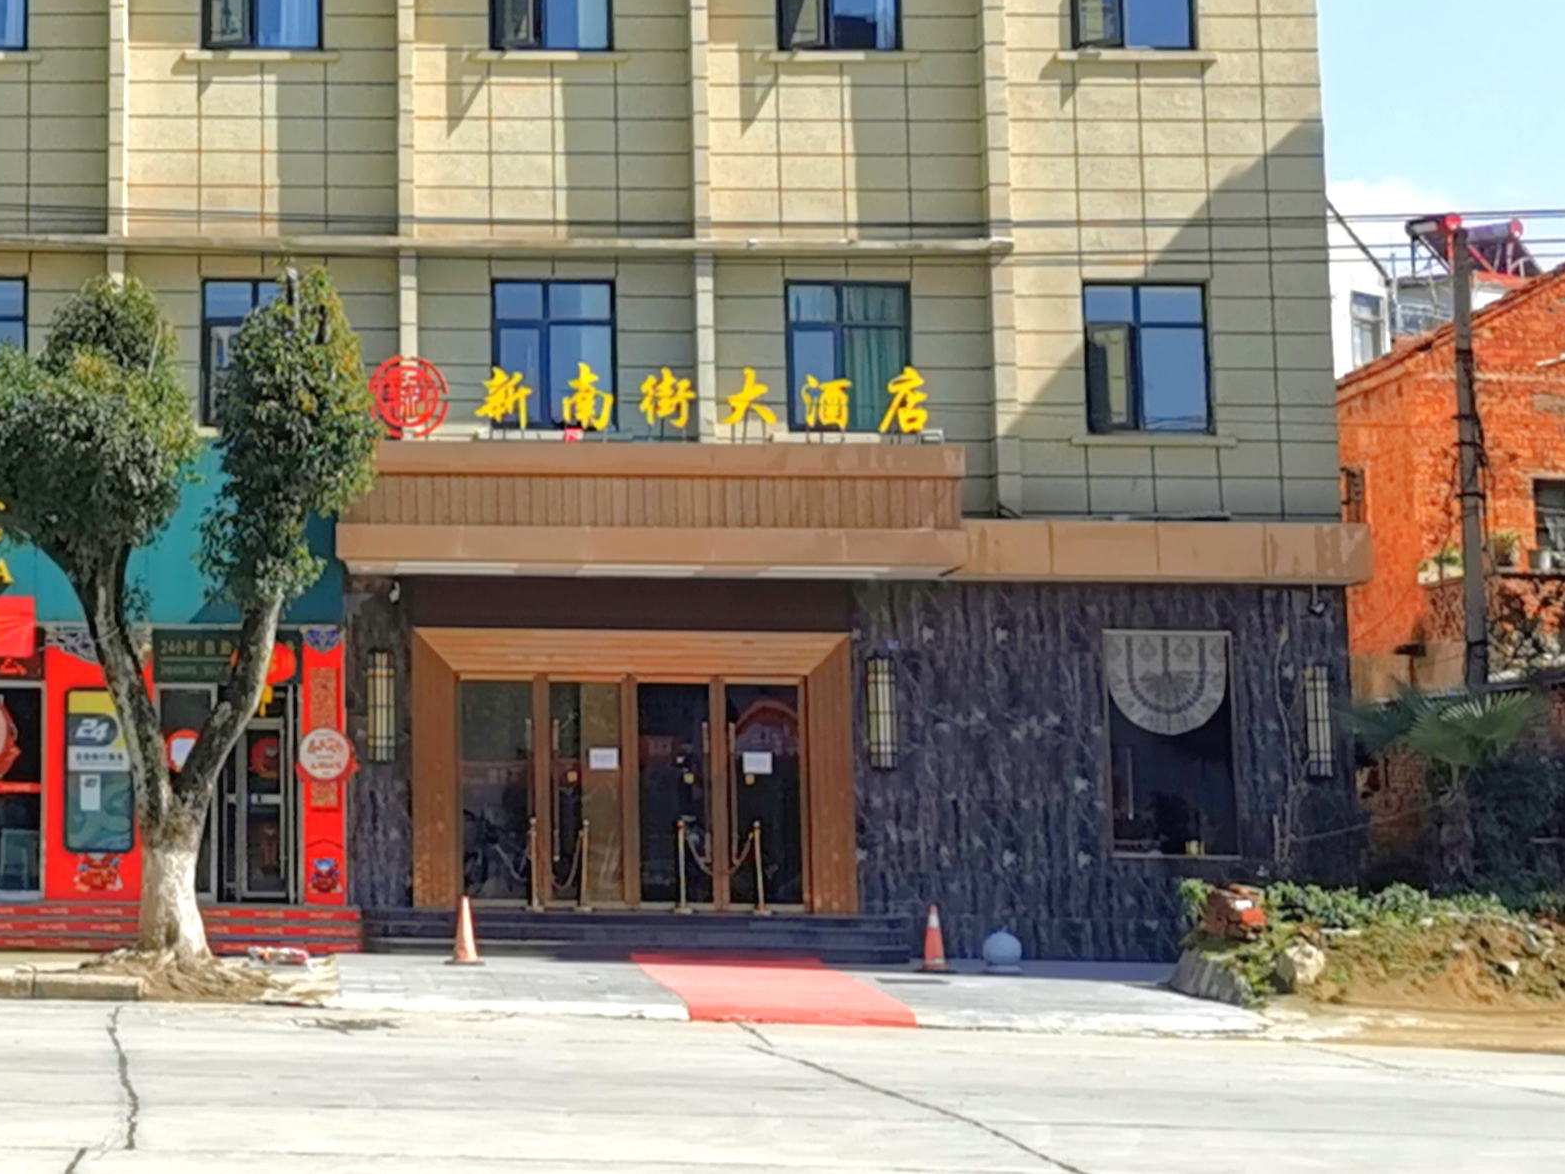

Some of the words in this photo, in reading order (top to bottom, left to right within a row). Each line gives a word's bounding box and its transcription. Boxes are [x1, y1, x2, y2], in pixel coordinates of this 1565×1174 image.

[474, 362, 929, 434] 新南街大酒店
[74, 717, 110, 742] 24
